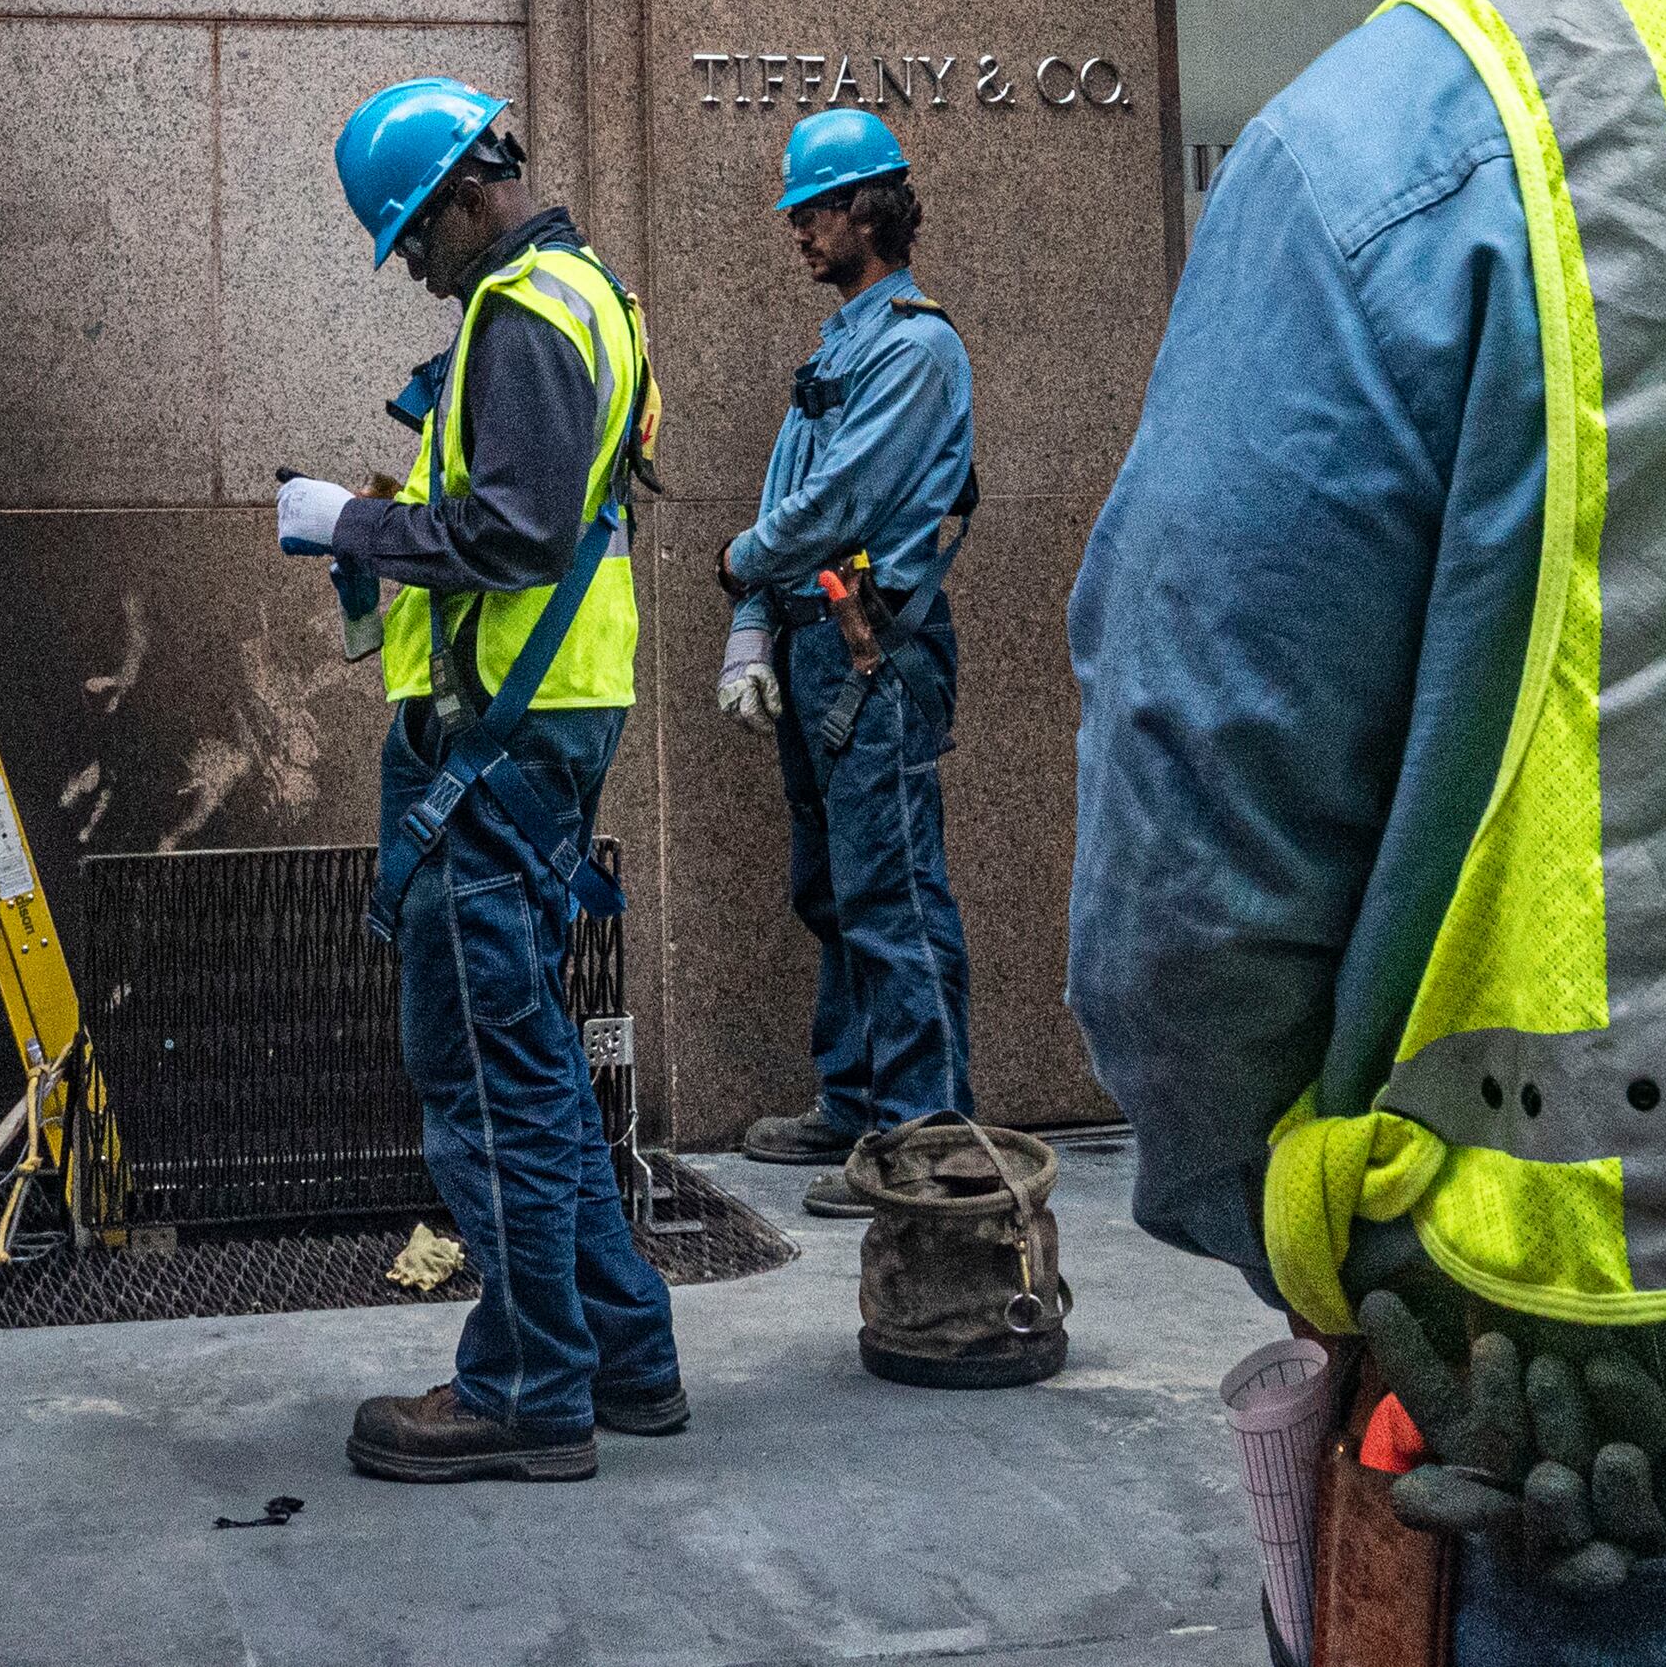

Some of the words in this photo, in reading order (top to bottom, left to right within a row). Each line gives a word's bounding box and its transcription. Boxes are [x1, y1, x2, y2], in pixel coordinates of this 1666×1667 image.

[692, 53, 956, 106] TIFFANY
[976, 53, 1017, 104] &
[1036, 55, 1131, 105] CO.
